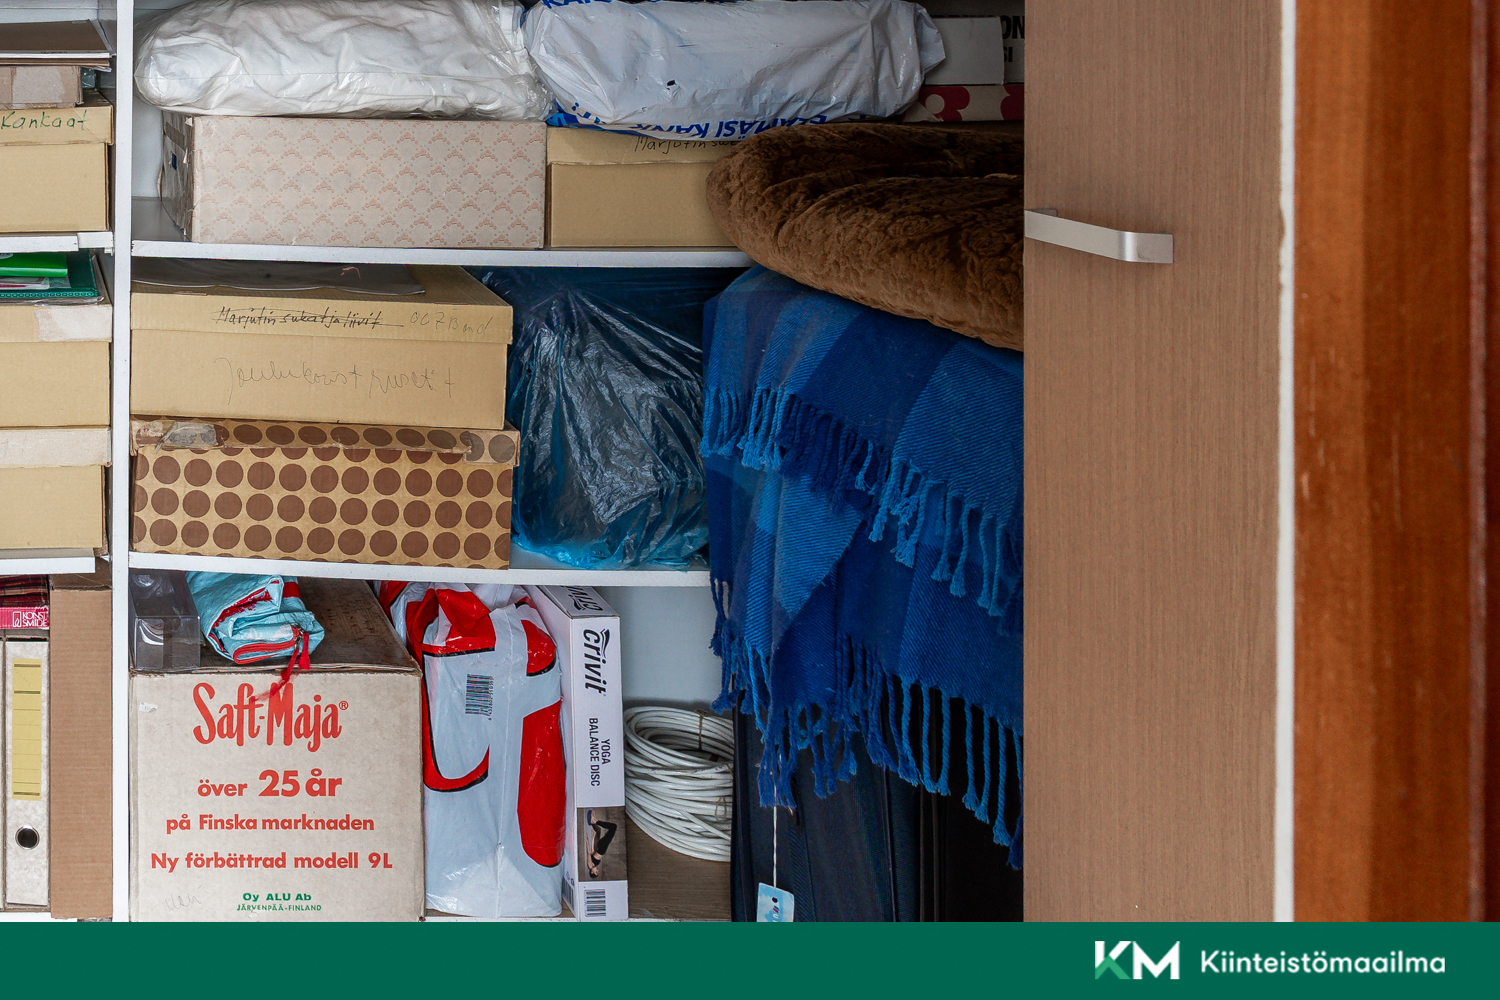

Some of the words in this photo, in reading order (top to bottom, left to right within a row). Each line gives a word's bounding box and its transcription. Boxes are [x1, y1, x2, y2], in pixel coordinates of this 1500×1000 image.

[22, 619, 48, 627] SMIDE
[583, 628, 609, 695] crivit
[588, 717, 600, 762] BALANCE
[600, 738, 611, 766] YOGA
[197, 779, 248, 797] över
[258, 769, 301, 797] 25
[305, 768, 343, 797] år
[590, 764, 600, 787] DISC
[166, 813, 191, 834] på
[199, 814, 258, 830] Finska
[261, 814, 375, 831] marknaden
[151, 852, 179, 873] Ny
[184, 851, 287, 869] förbättrad
[294, 852, 359, 869] modell
[368, 852, 393, 869] 9L
[242, 893, 260, 903] Oy
[266, 893, 292, 901] ALU
[295, 893, 312, 901] Ab
